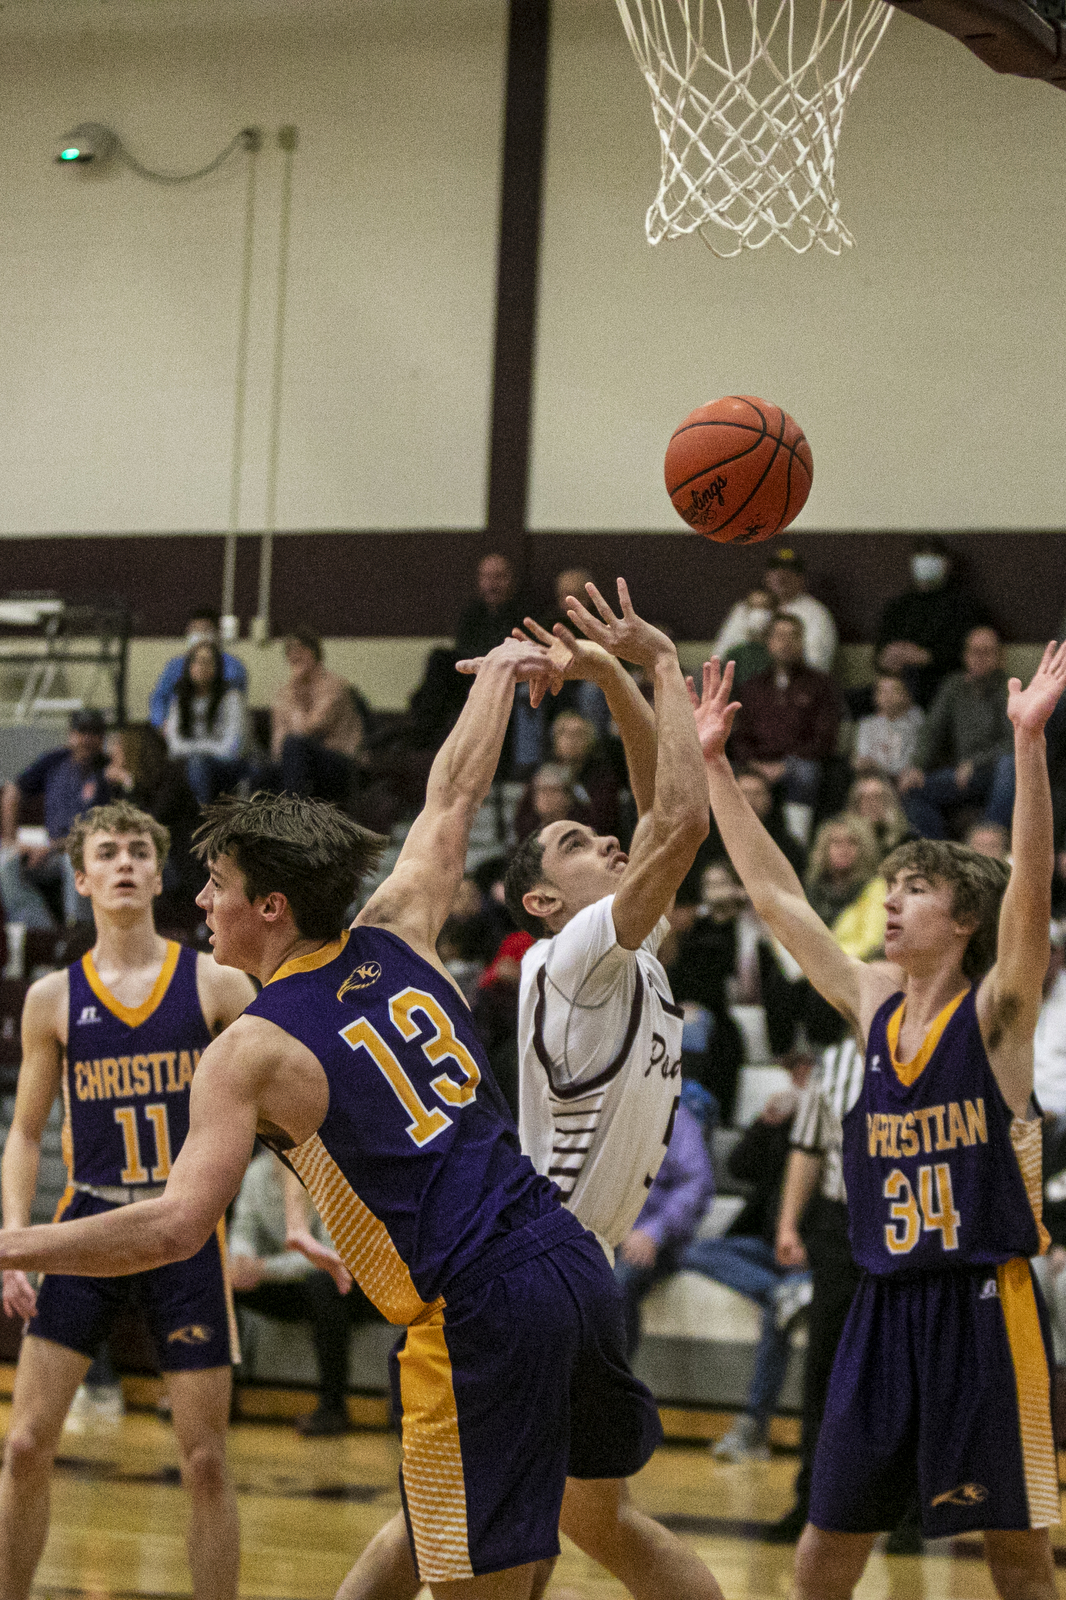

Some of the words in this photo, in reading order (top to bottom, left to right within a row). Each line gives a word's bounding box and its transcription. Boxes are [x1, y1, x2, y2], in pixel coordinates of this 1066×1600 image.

[338, 986, 481, 1148] 13
[114, 1104, 172, 1183] 11
[866, 1098, 988, 1158] RISTIAN
[884, 1162, 961, 1255] 34
